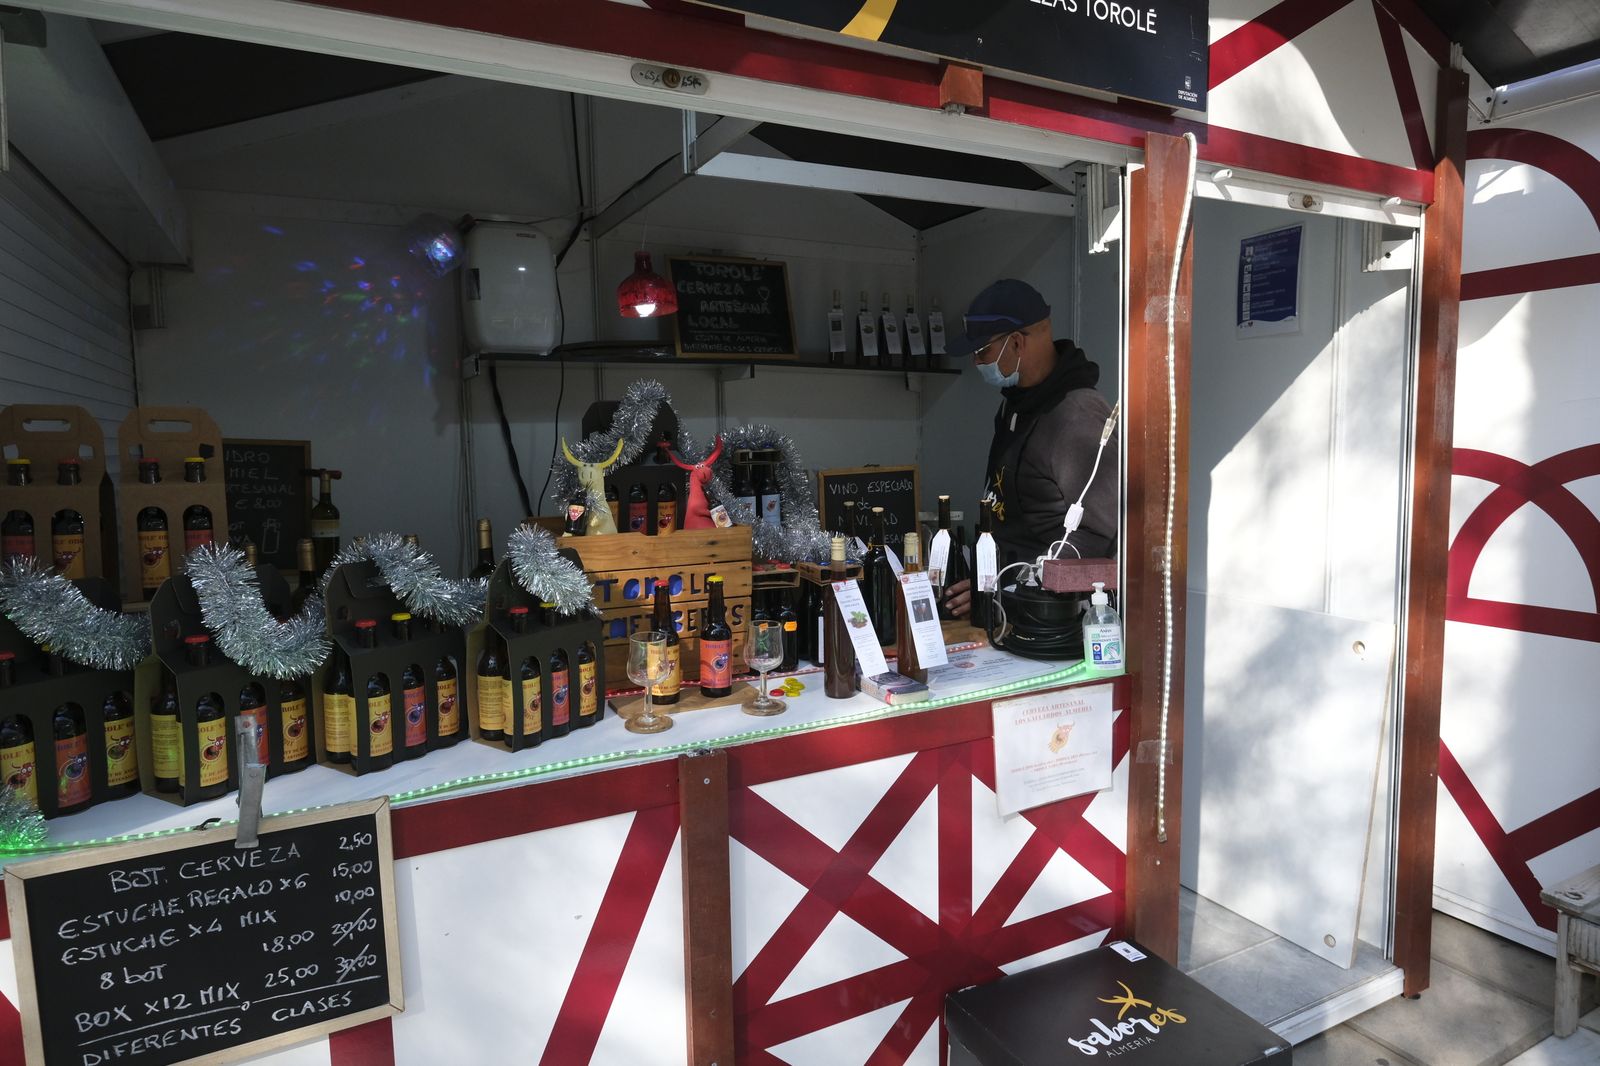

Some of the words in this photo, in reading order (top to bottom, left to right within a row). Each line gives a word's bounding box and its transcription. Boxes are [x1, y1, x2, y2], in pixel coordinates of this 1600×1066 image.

[677, 279, 745, 296] CERVEZA
[829, 482, 859, 496] VINO
[179, 841, 301, 880] CERVEZA
[338, 831, 373, 851] 2,50
[57, 896, 184, 940] ESTUCHE
[186, 879, 274, 909] REGALO
[332, 859, 374, 880] 15,00
[61, 927, 181, 967] ESTUCHE
[239, 908, 278, 929] MIX
[334, 885, 376, 905] 10,00
[99, 971, 116, 991] 8
[262, 929, 316, 954] 18,00
[74, 1004, 133, 1033] BOX
[199, 981, 241, 1007] MIX
[264, 962, 320, 989] 25,00
[82, 1017, 243, 1066] DIFERENTES
[270, 990, 353, 1023] CLASES
